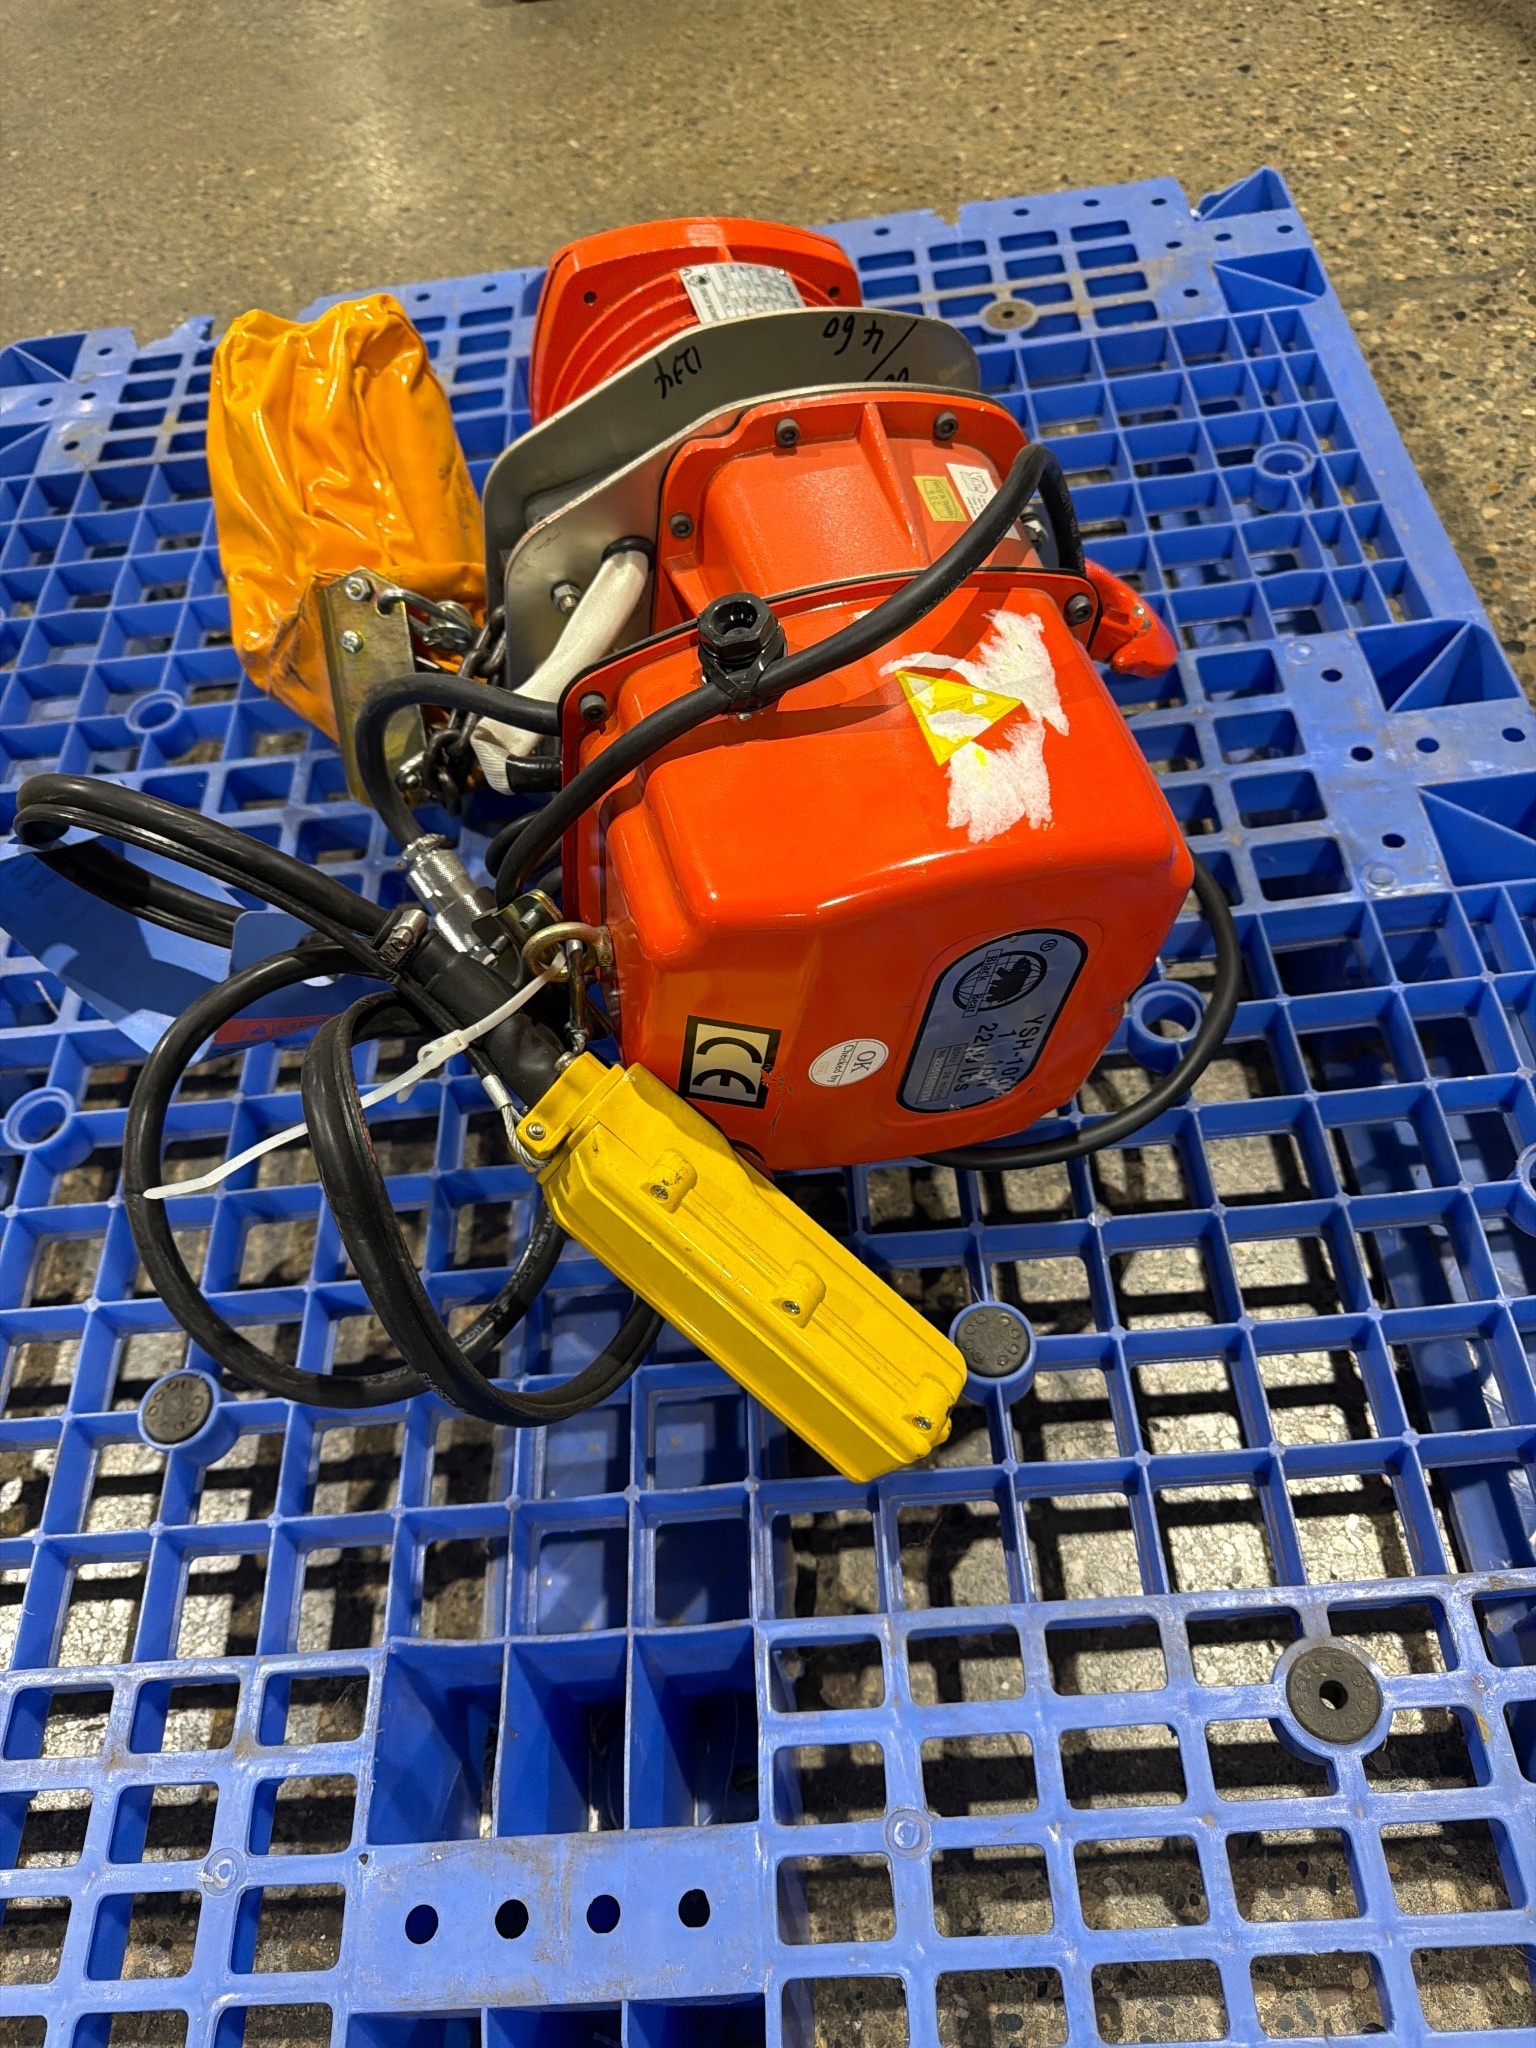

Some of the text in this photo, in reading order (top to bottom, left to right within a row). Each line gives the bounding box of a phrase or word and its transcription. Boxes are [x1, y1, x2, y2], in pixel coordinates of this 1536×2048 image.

[977, 955, 999, 982] Black
[966, 993, 983, 1013] Bear
[834, 1044, 855, 1081] Checked
[850, 1050, 877, 1074] OK
